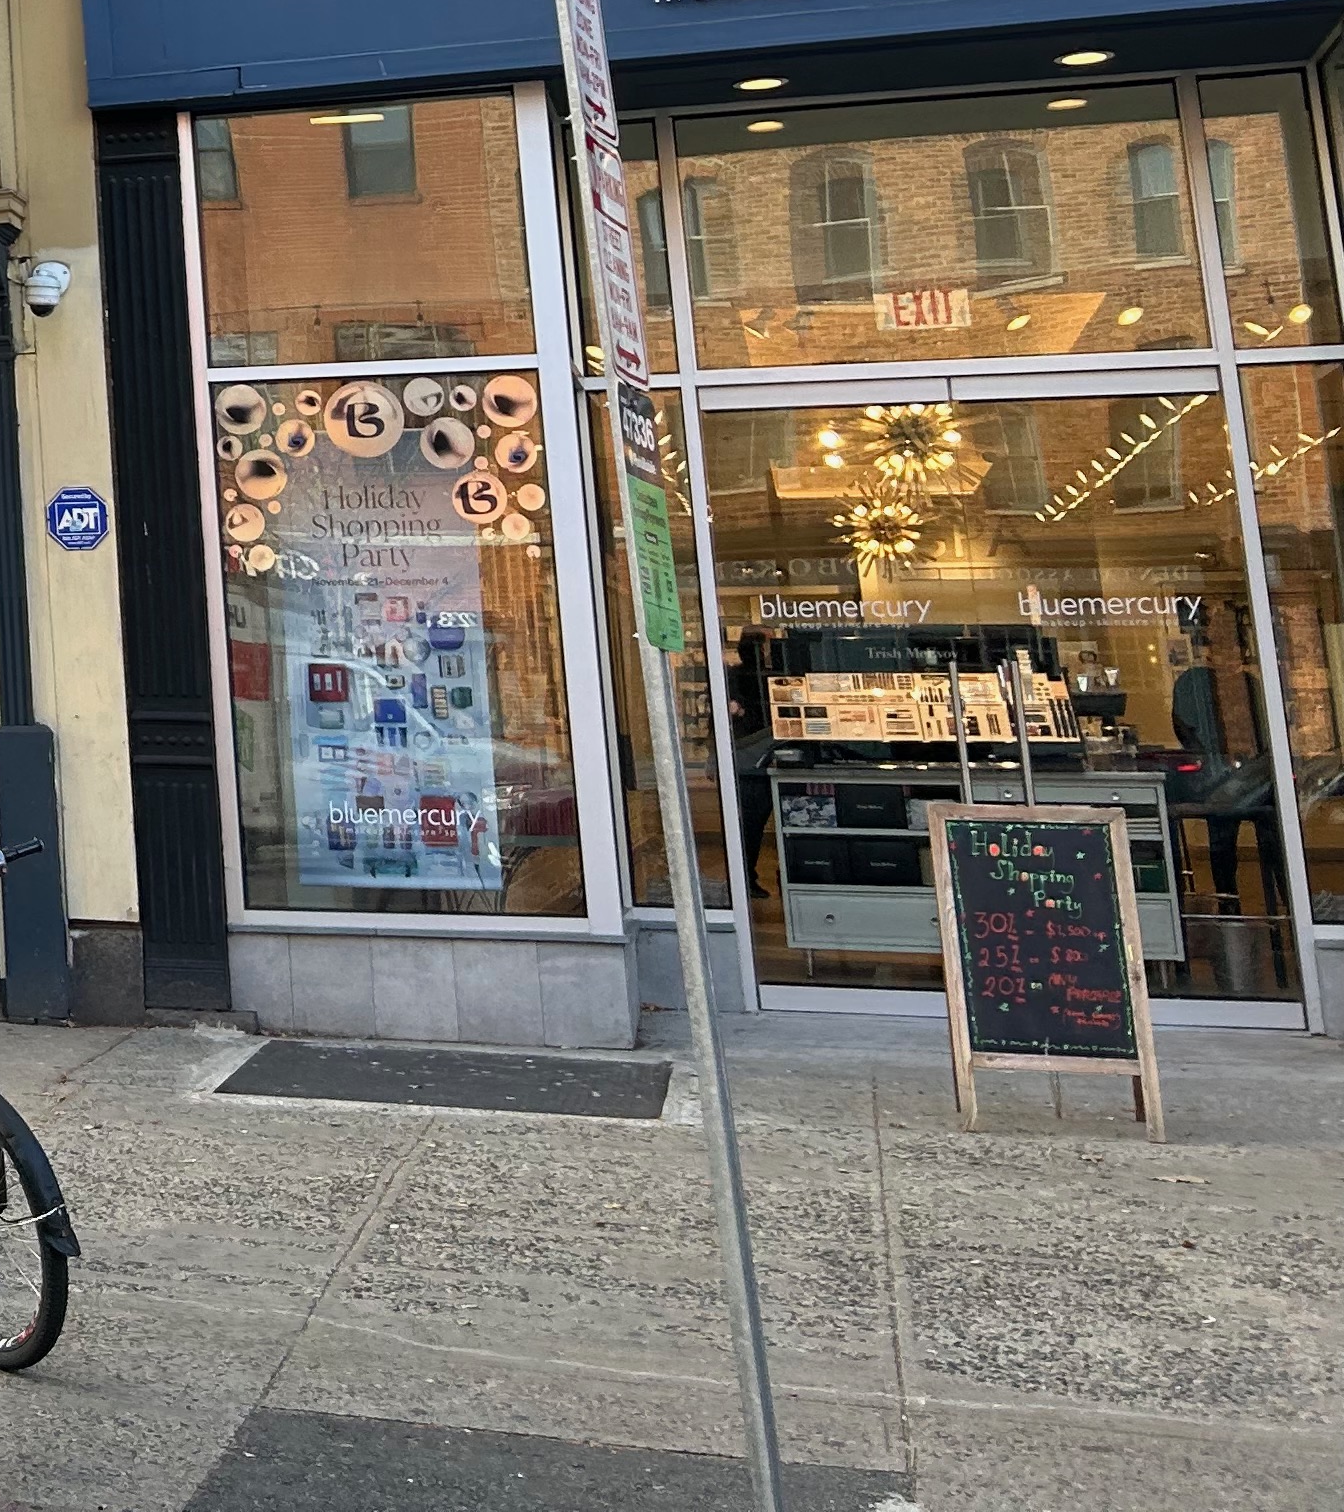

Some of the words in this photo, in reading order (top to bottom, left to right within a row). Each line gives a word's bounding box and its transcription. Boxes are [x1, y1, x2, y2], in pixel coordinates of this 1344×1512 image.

[892, 290, 953, 327] EXIT
[623, 406, 655, 452] 47336
[322, 484, 426, 515] Holiday
[58, 508, 98, 529] ADT
[312, 514, 442, 543] Shopping
[341, 543, 416, 573] Party
[759, 594, 932, 624] bluemercury
[1018, 591, 1202, 620] bluemercury
[865, 646, 903, 660] Trish
[329, 800, 481, 832] bluemercury
[970, 830, 1056, 870] Holiday
[989, 858, 1075, 895] Shopping
[1033, 889, 1083, 919] Party
